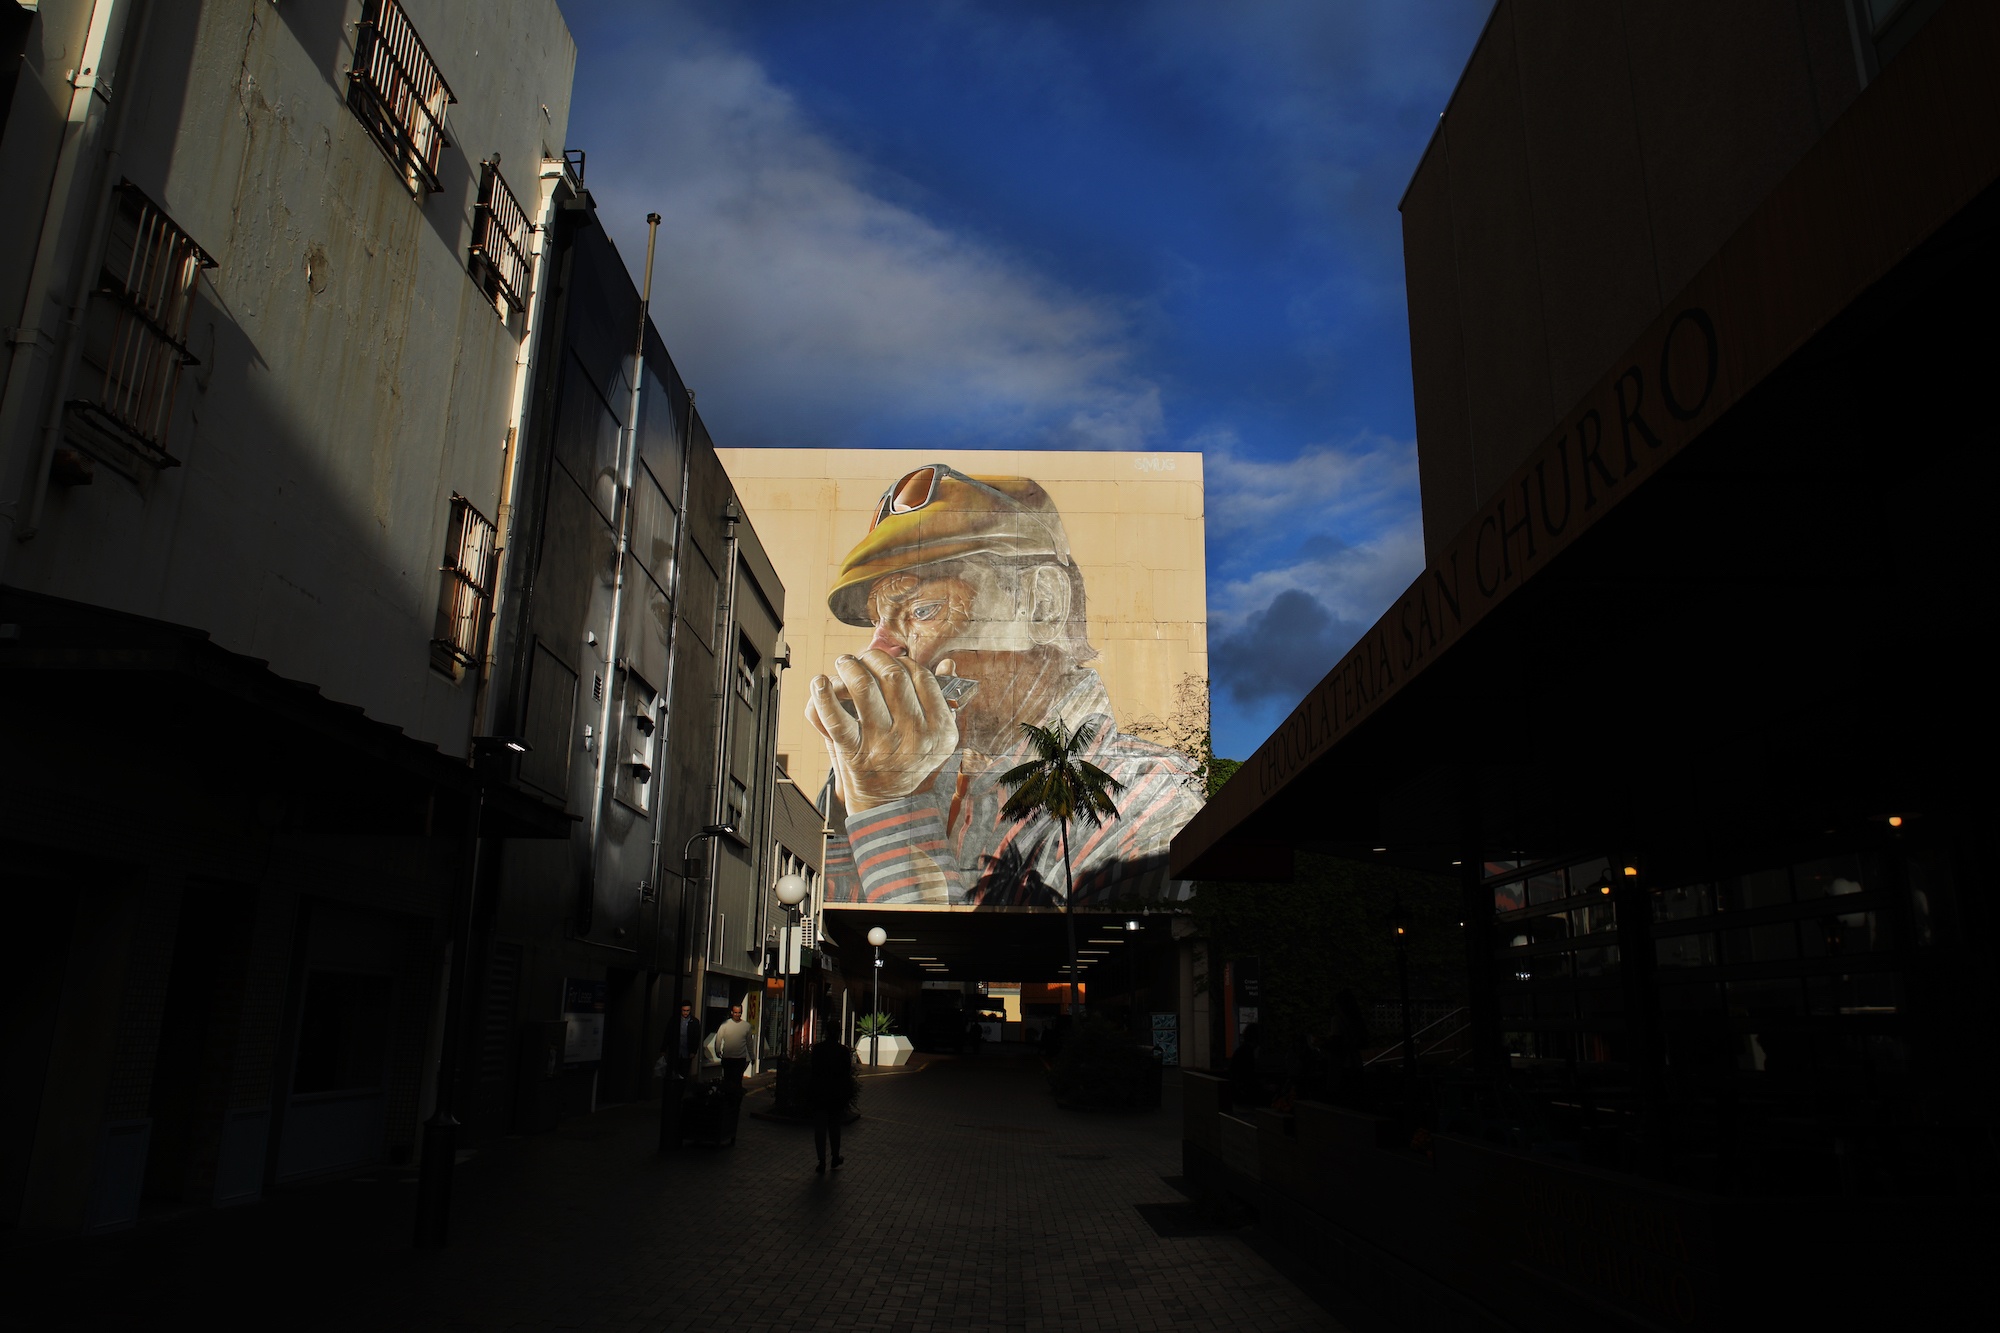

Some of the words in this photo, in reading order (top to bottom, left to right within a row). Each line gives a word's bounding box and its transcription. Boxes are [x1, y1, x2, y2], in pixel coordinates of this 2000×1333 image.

[1258, 630, 1394, 796] CHOCOLATERIA
[1402, 549, 1462, 671] SAN
[1475, 307, 1718, 598] CHURRO
[1521, 1175, 1690, 1263] CHOCOLATERIA
[1524, 1219, 1566, 1267] SAN
[1578, 1239, 1696, 1324] CHURRO
